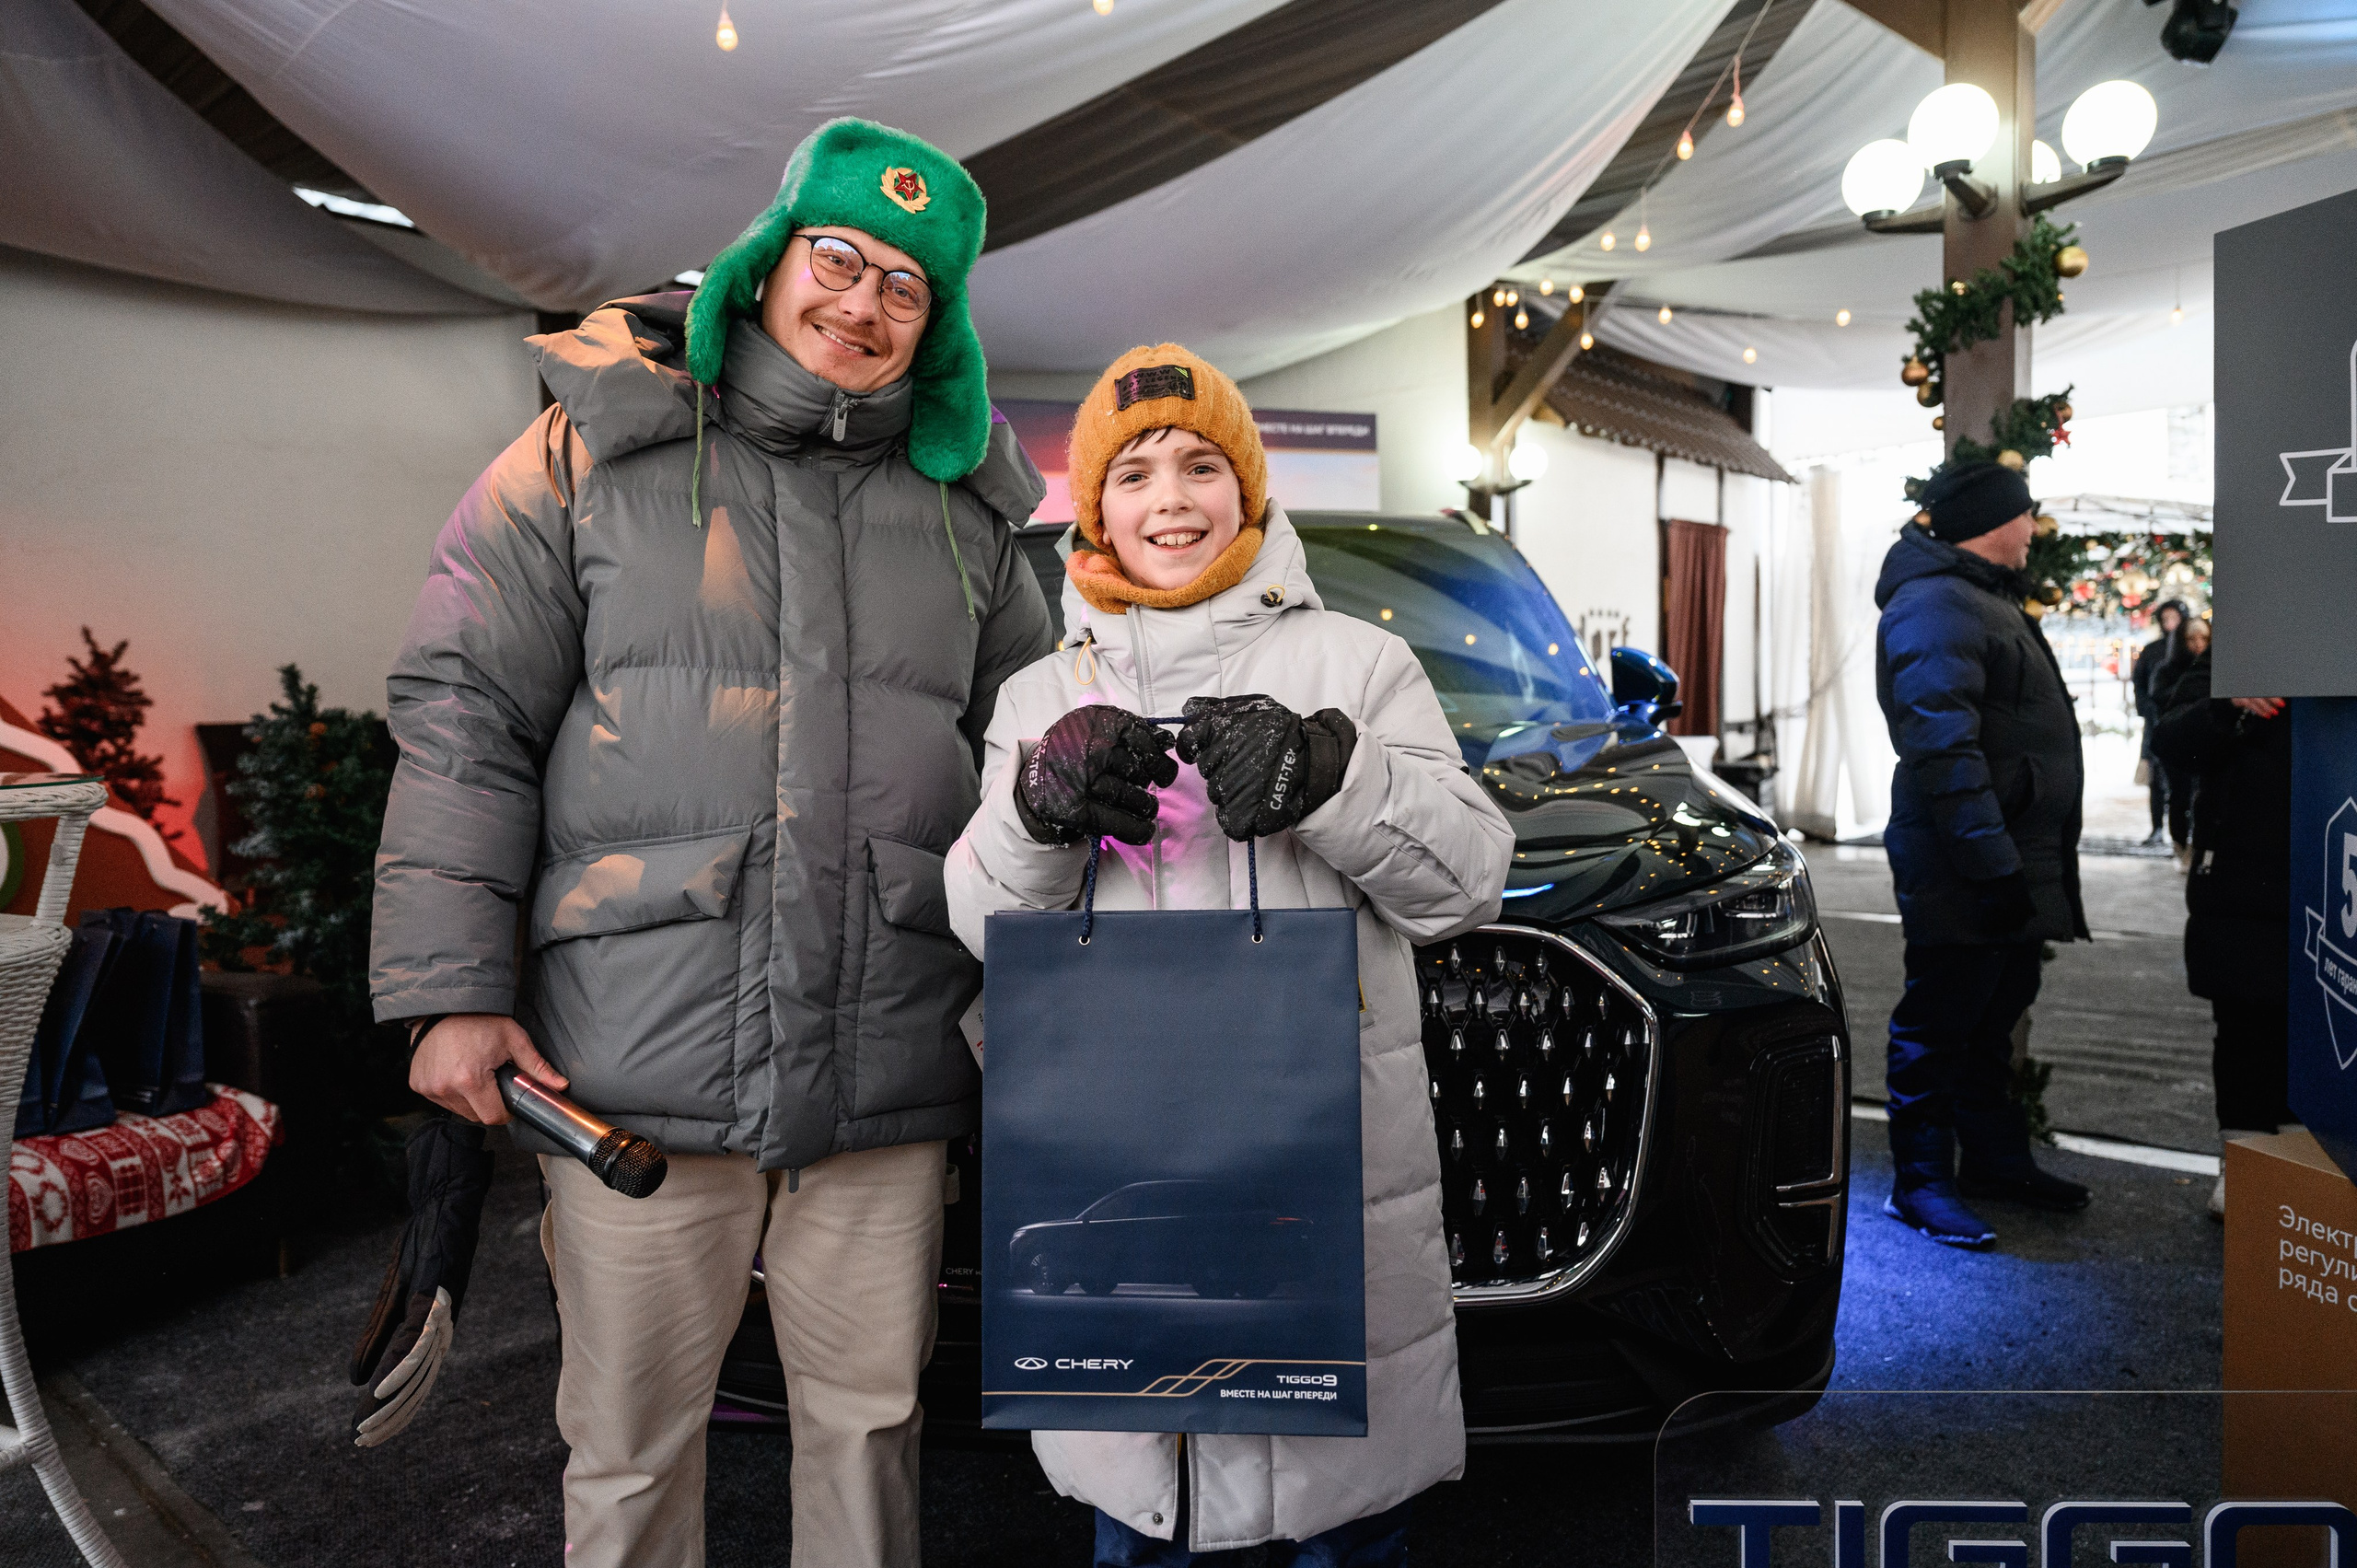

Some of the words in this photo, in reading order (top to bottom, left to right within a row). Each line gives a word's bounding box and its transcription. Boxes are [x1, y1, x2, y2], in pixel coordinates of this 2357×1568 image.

[1270, 748, 1296, 810] CAST-TEX
[945, 1267, 974, 1276] CHERY
[2279, 1267, 2338, 1305] ряда
[1055, 1358, 1134, 1370] CHERY
[1220, 1388, 1256, 1399] ВМЕСТЕ
[1257, 1389, 1271, 1399] НА
[1271, 1390, 1294, 1400] ШАГ
[1294, 1390, 1338, 1401] ВПЕРЕДИ
